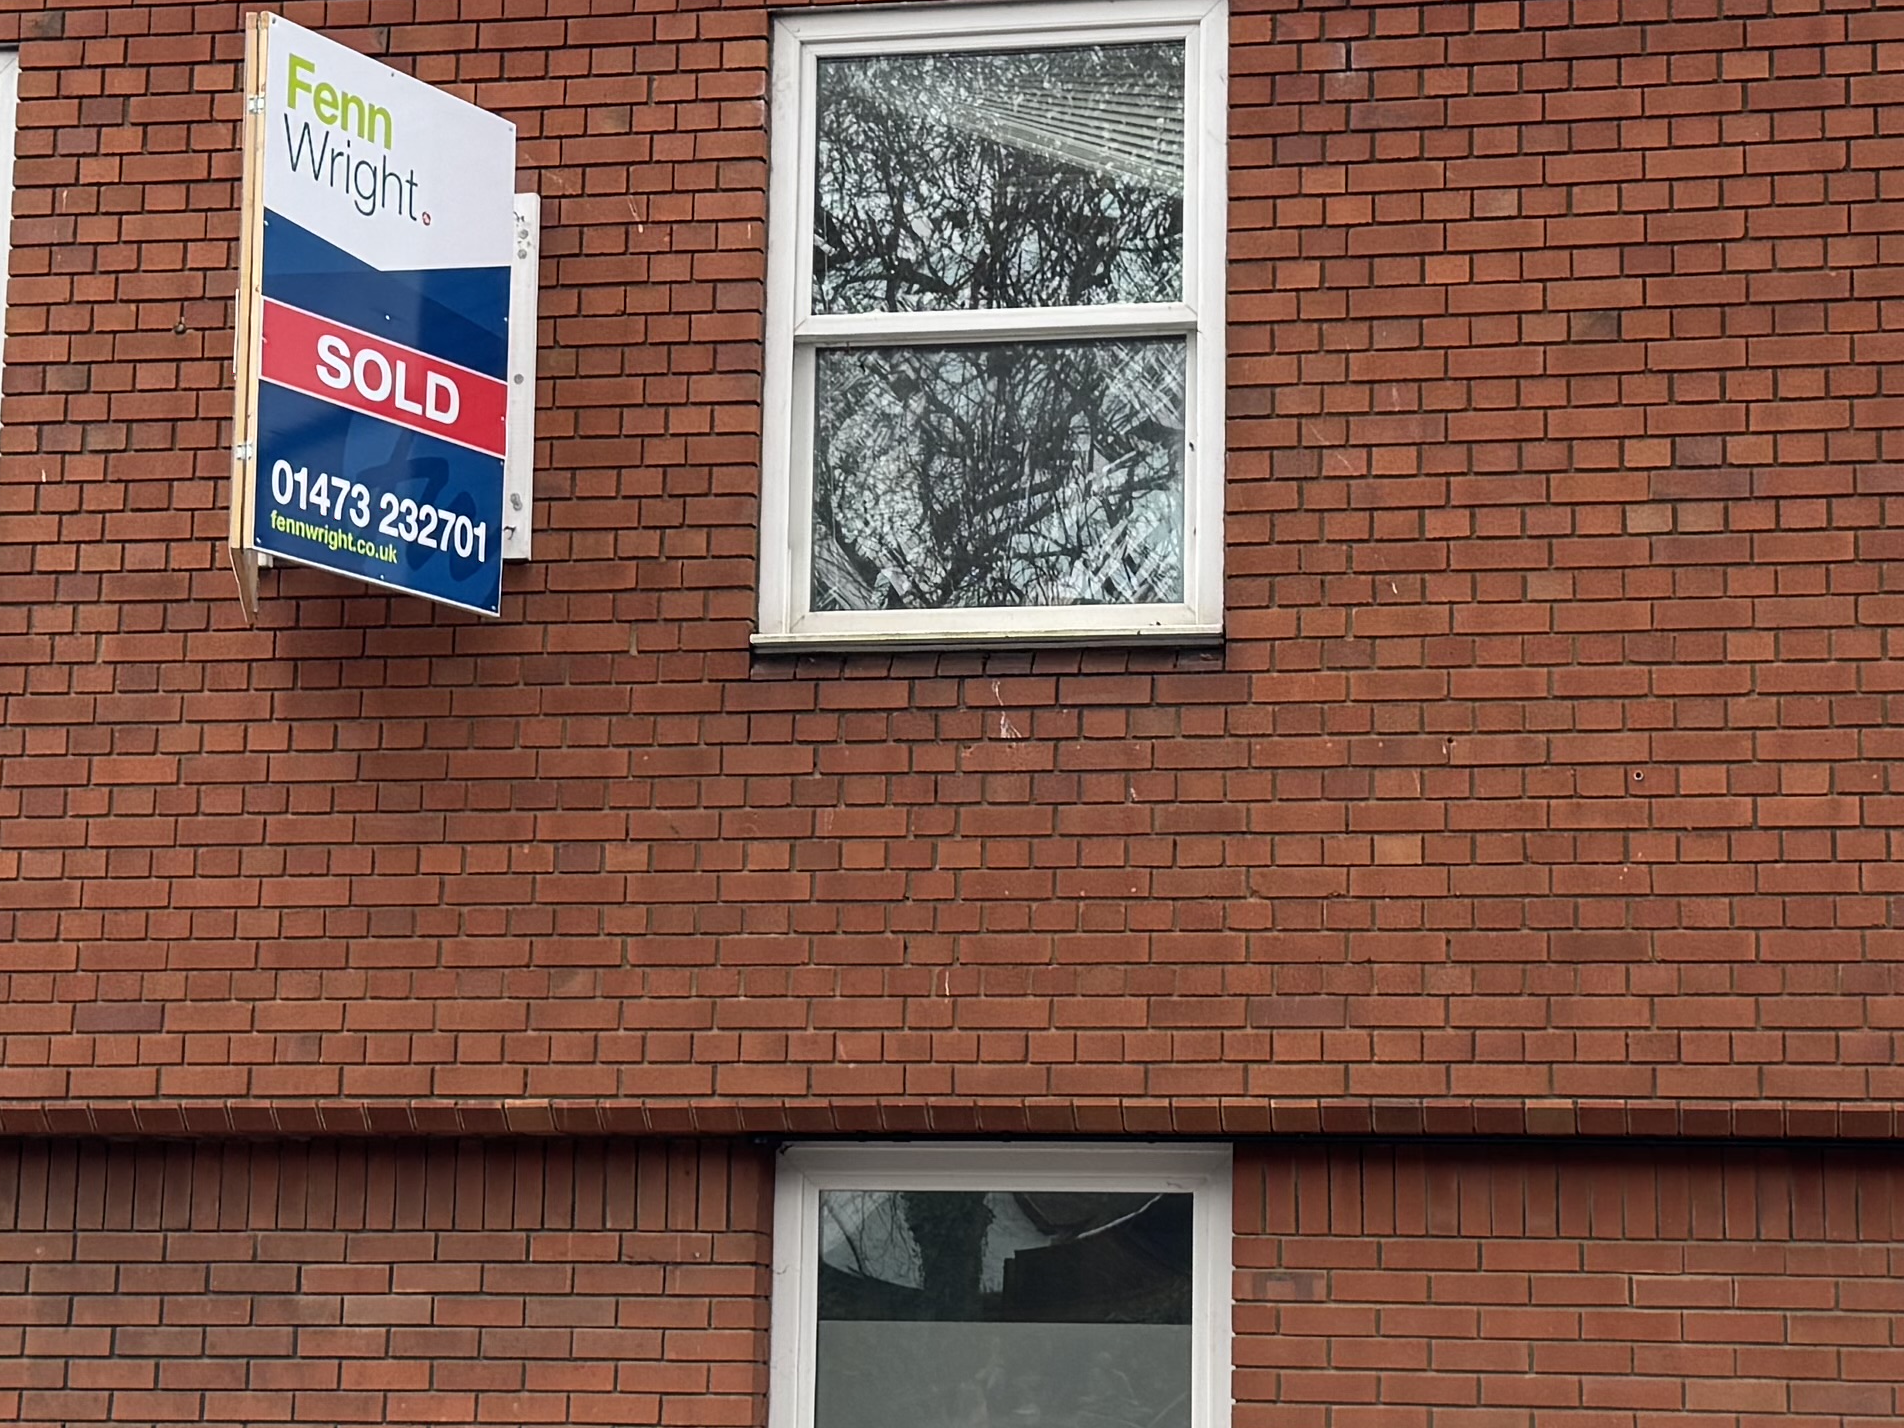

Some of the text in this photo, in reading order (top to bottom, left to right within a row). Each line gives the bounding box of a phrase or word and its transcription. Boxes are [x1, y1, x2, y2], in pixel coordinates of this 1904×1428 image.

[286, 52, 393, 151] Fenn
[315, 334, 461, 426] SOLD
[270, 509, 398, 565] fennwright.co.uk
[271, 459, 488, 563] 01473 232701
